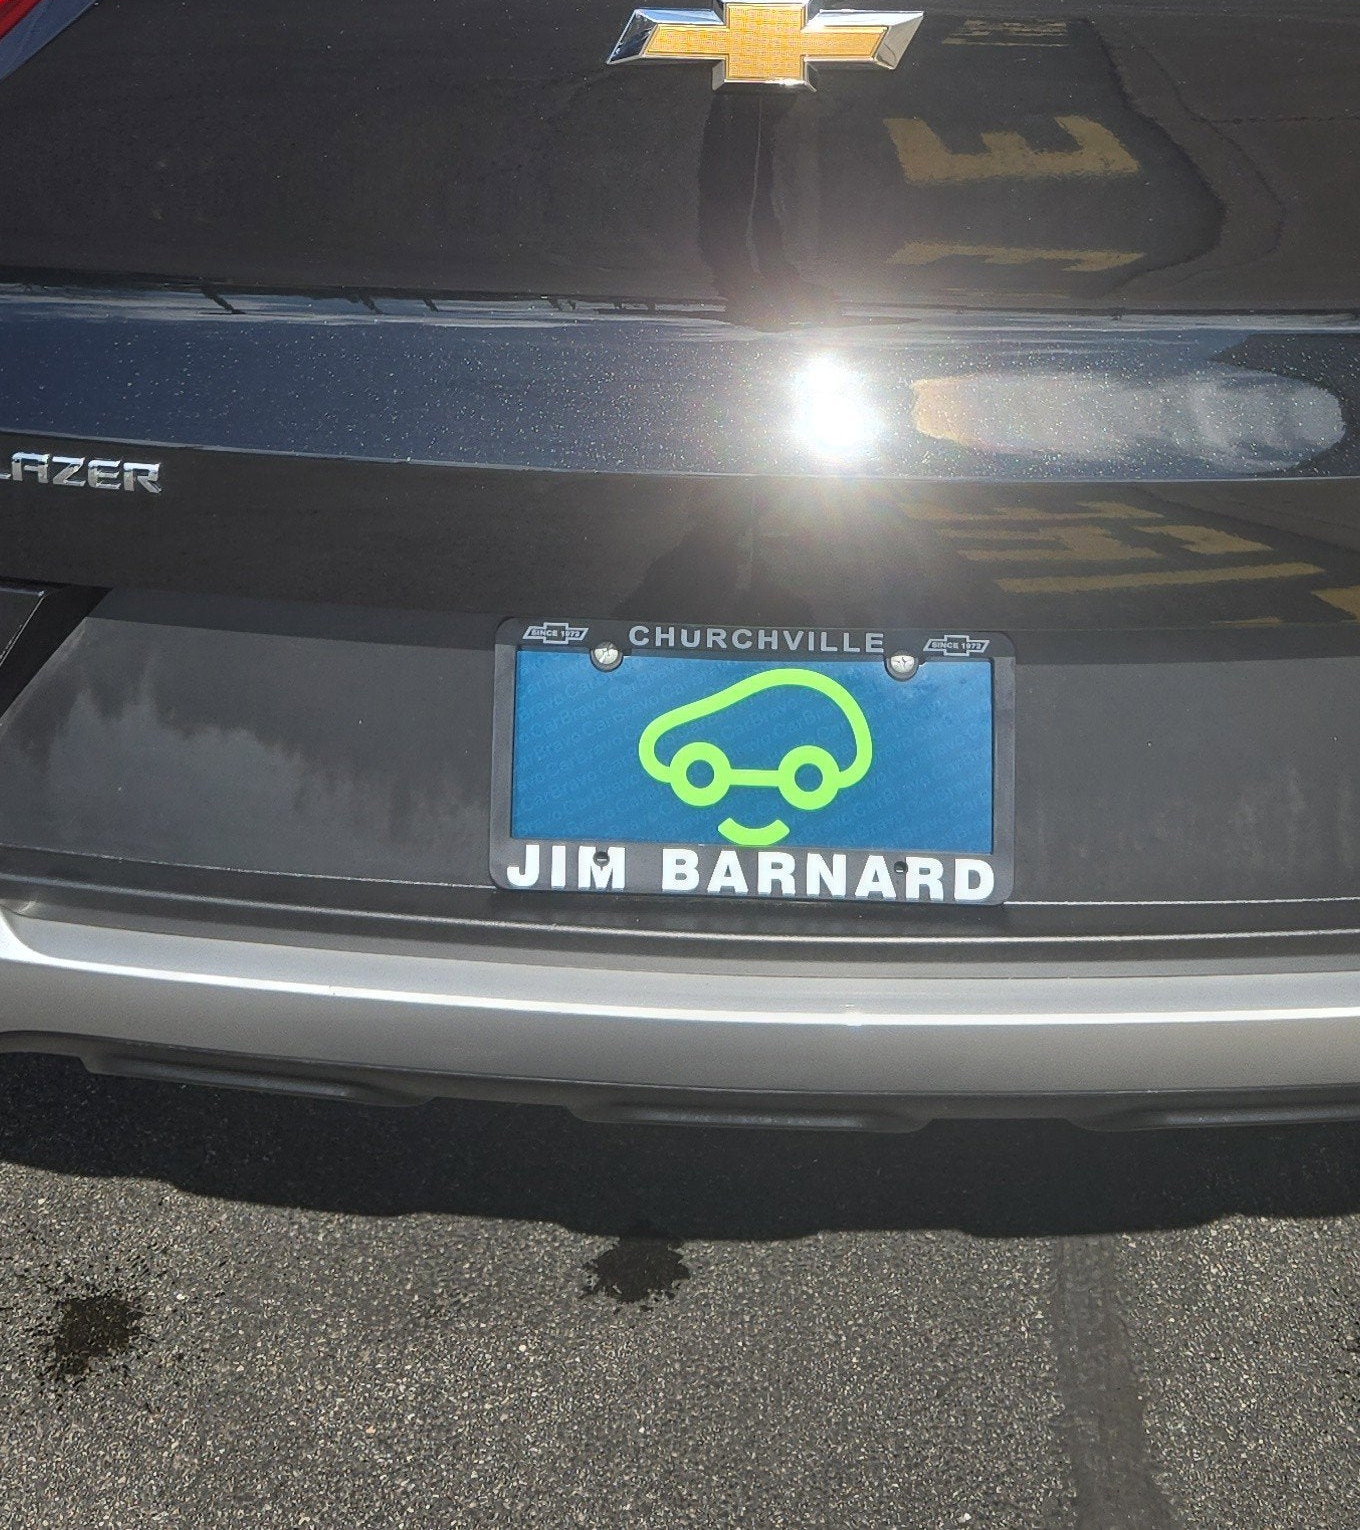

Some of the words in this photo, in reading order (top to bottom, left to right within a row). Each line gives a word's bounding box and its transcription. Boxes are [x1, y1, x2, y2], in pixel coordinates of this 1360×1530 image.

[531, 629, 558, 637] SINCE
[628, 625, 885, 654] CHURCHVILLE
[931, 641, 959, 649] SINCE
[507, 844, 626, 889] JIM
[662, 849, 995, 901] BARNARD
